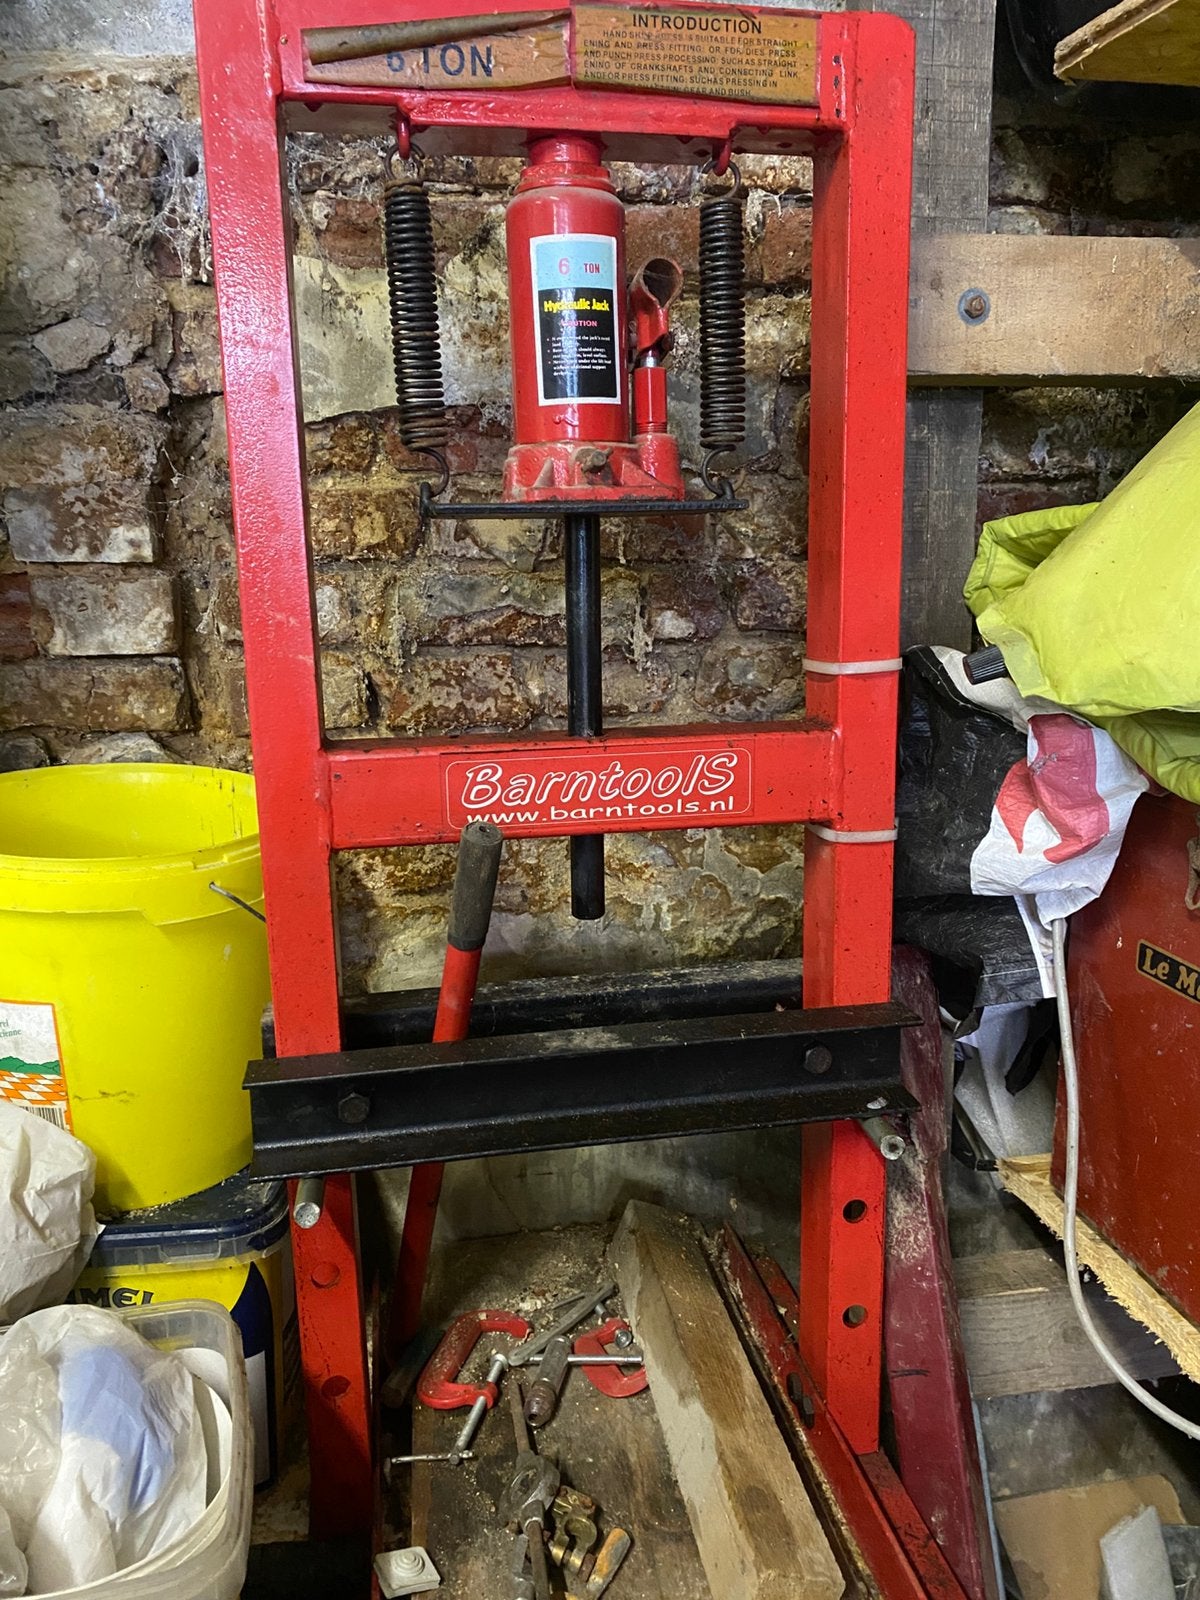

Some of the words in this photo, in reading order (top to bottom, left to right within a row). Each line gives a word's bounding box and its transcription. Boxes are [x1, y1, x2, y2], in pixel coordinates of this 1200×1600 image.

[632, 14, 762, 34] INTRODUCTION
[603, 30, 627, 38] HAND
[695, 34, 735, 44] SUITABLE
[738, 37, 754, 46] FOR
[756, 38, 798, 48] STRAIGHT
[583, 40, 610, 48] ENING
[614, 41, 632, 49] AND
[636, 42, 665, 50] PRESS
[709, 46, 720, 54] OR
[746, 48, 765, 56] DIES
[768, 49, 796, 58] PRESS
[386, 51, 404, 72] 6
[422, 44, 492, 77] TON
[584, 50, 601, 58] AND
[634, 52, 661, 60] PRESS
[721, 57, 745, 65] SUCH
[746, 58, 756, 66] AS
[758, 59, 797, 68] STRAIGHT
[584, 61, 610, 69] ENING
[630, 62, 694, 73] CRANKSHAFTS
[698, 66, 716, 74] AND
[719, 67, 773, 77] CONNECTING
[622, 72, 650, 81] PRESS
[726, 77, 768, 88] PRESSING
[769, 80, 778, 88] IN
[708, 88, 726, 96] AND
[728, 88, 751, 97] BUSH
[558, 258, 570, 276] 6
[584, 263, 600, 274] TON
[544, 298, 590, 313] Hydraulic
[592, 298, 610, 311] Jack
[467, 796, 734, 823] www.barntools.nl
[1142, 947, 1170, 980] Le
